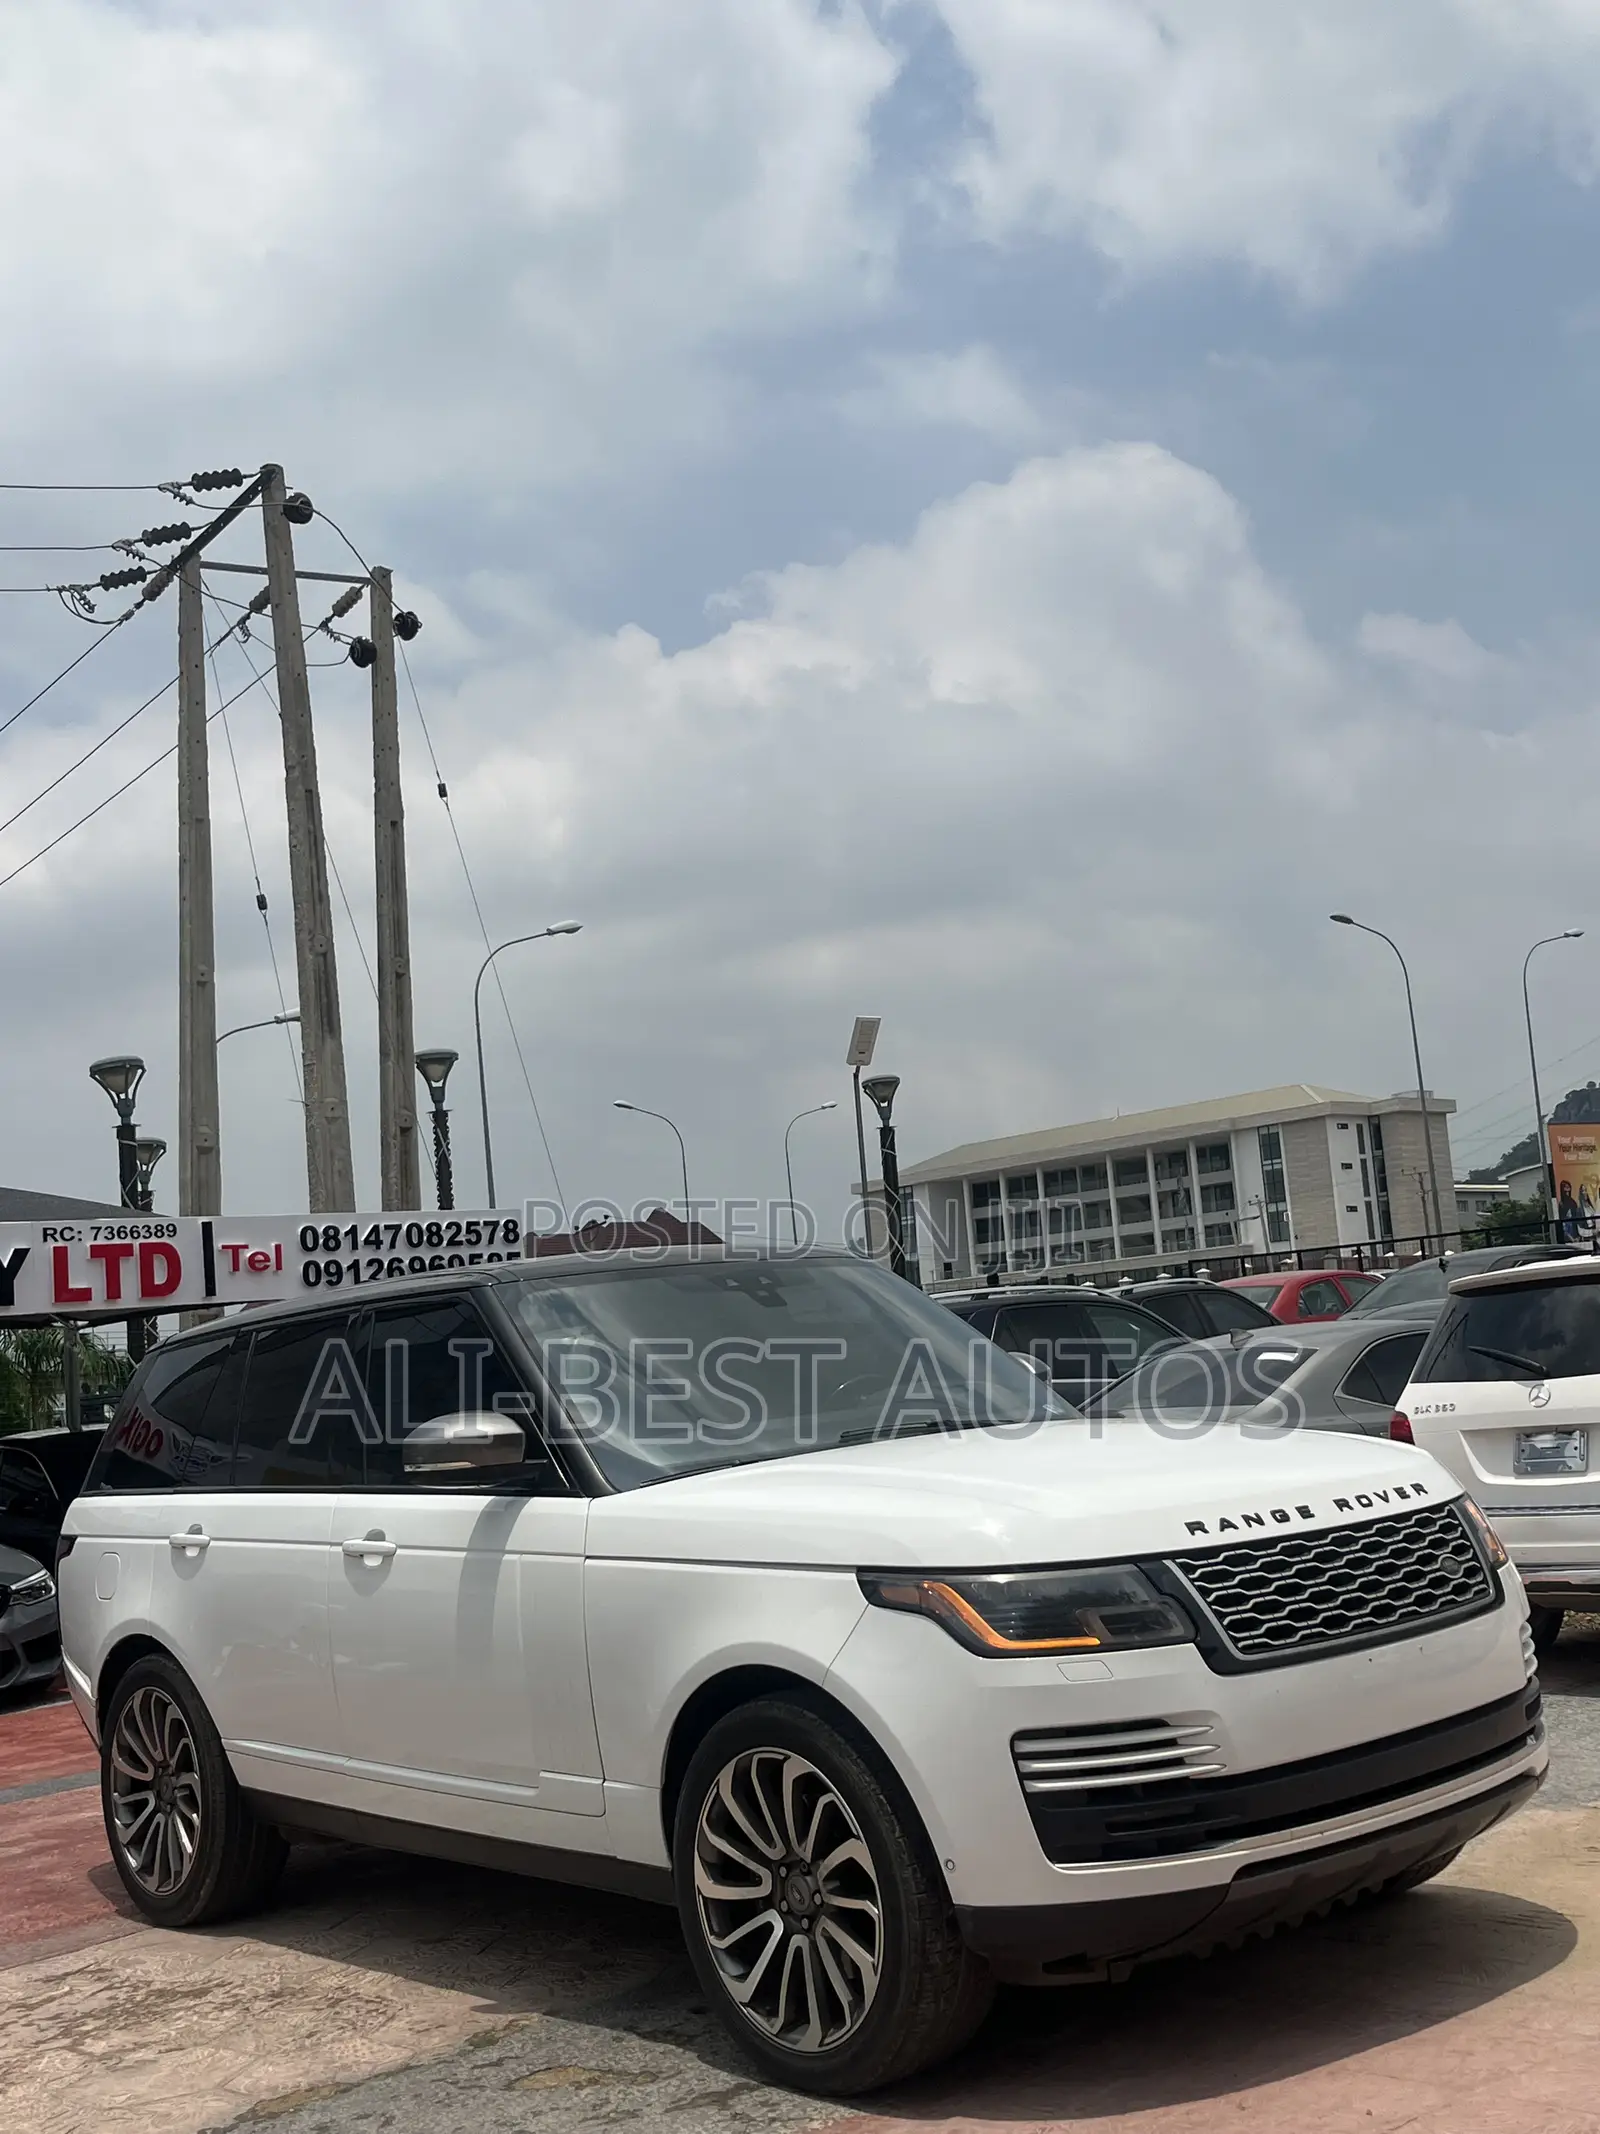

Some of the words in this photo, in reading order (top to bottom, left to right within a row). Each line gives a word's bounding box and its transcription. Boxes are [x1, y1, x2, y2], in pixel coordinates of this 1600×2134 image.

[42, 1226, 83, 1243] RC:
[90, 1223, 178, 1241] 7366389
[300, 1218, 521, 1252] 08147082578
[53, 1241, 183, 1304] LTD
[221, 1243, 284, 1273] Tel
[1184, 1504, 1316, 1536] RANGE
[1331, 1482, 1429, 1513] ROVER
